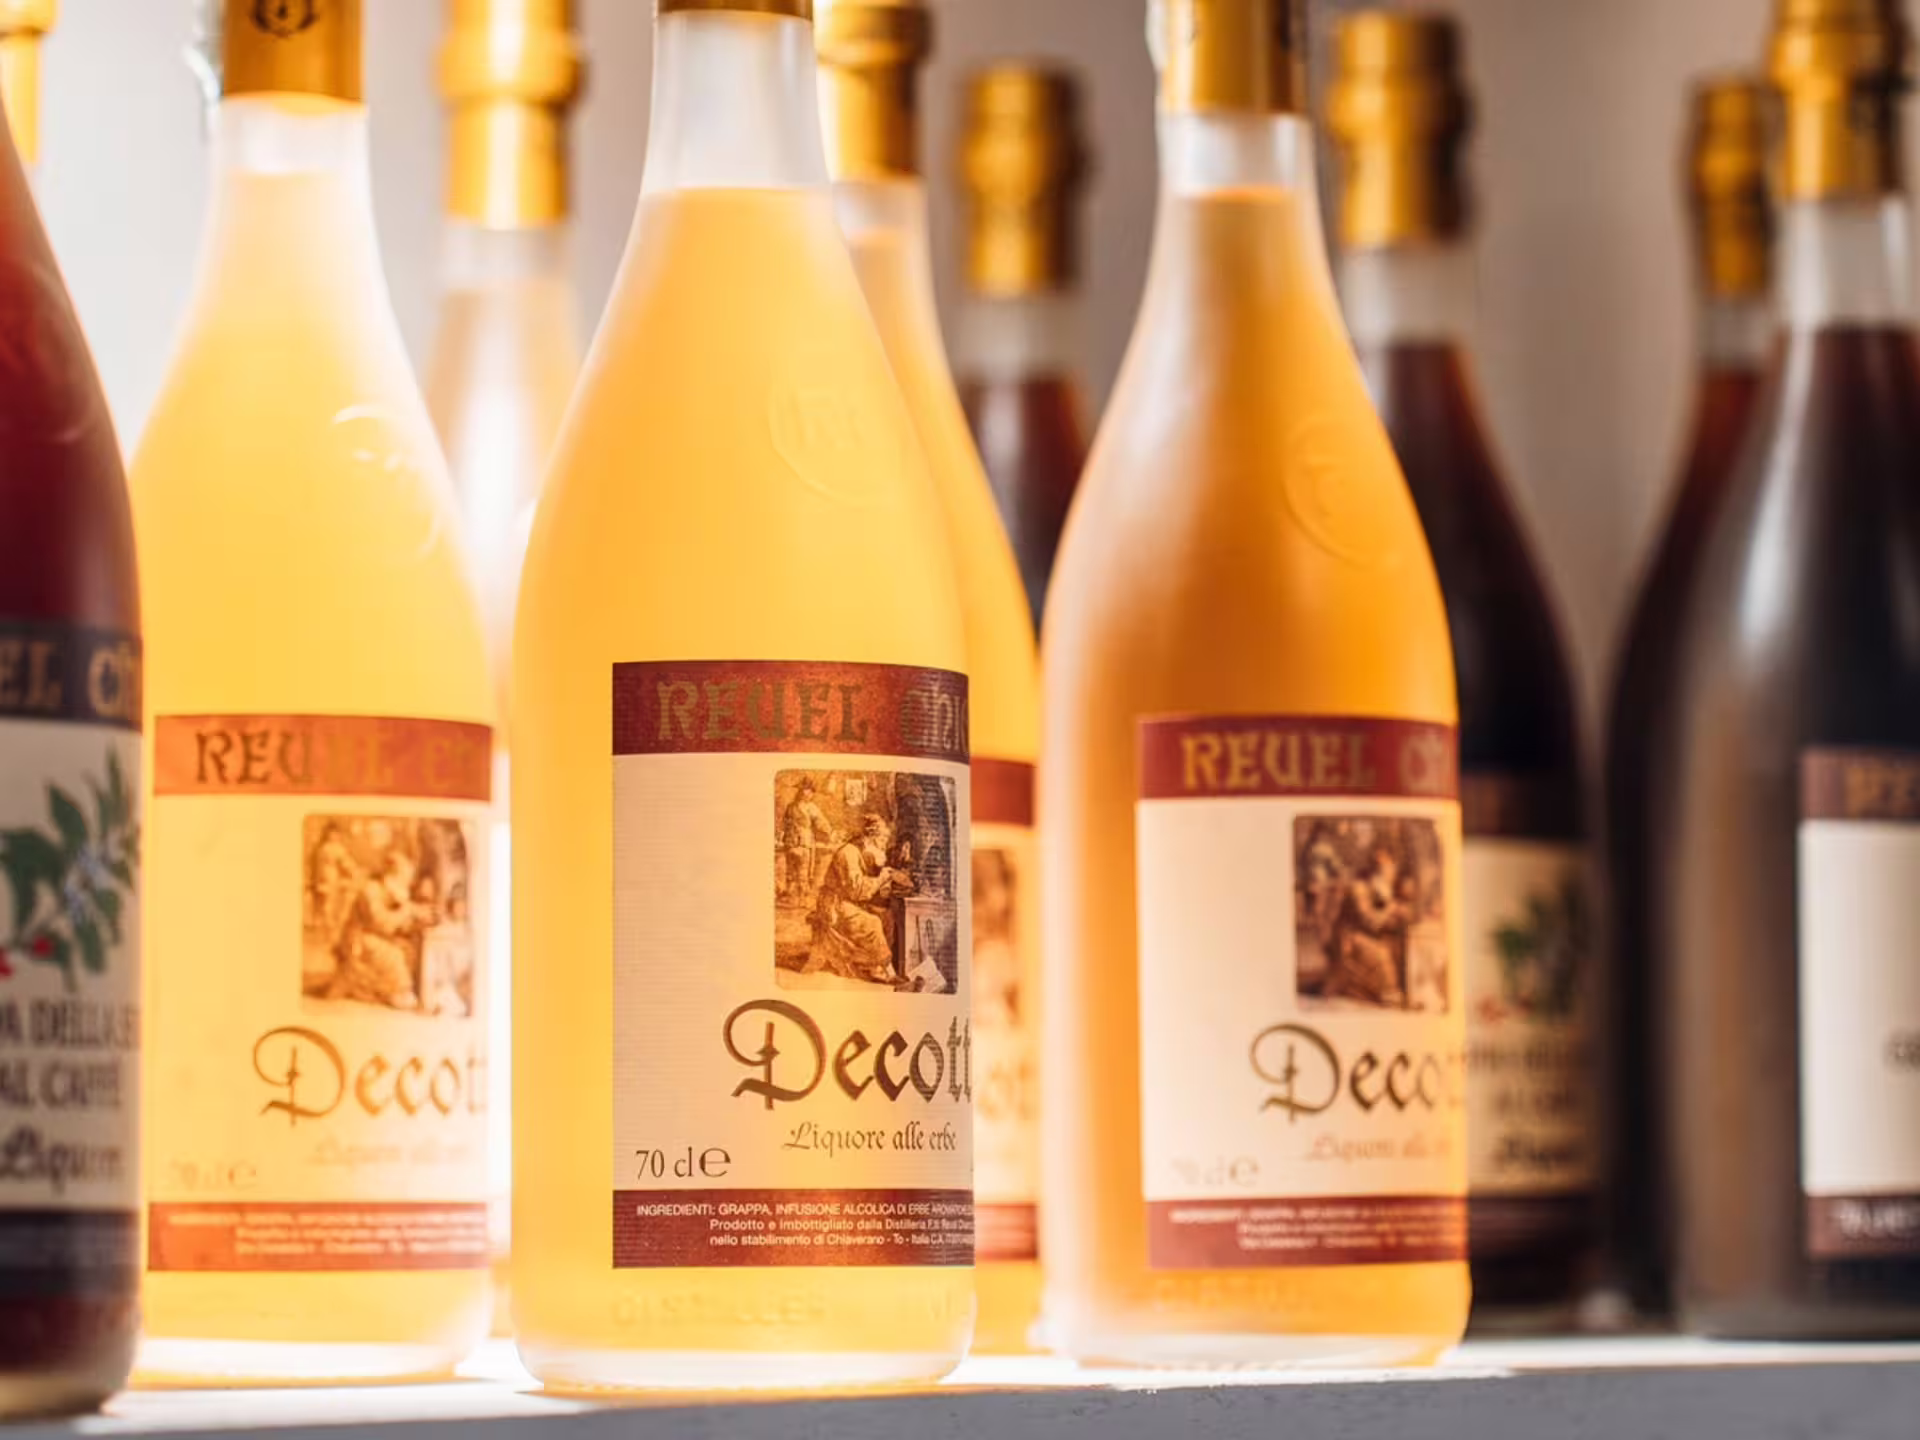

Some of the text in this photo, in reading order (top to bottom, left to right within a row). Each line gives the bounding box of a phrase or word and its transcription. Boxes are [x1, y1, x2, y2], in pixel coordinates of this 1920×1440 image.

[781, 1121, 885, 1158] Liquore
[892, 1121, 924, 1150] alle
[636, 1149, 665, 1181] 70
[636, 1204, 715, 1216] INGREDIENTI:
[775, 1203, 840, 1216] INFUSIONE
[843, 1203, 895, 1216] ALCOLICA
[710, 1219, 765, 1231] Prodotto
[769, 1221, 777, 1231] e
[780, 1219, 854, 1233] imbottigliato
[857, 1219, 882, 1230] dalla
[710, 1235, 738, 1246] nello
[741, 1234, 811, 1246] stabilimento
[814, 1234, 825, 1246] di
[827, 1233, 885, 1246] Chiaverano
